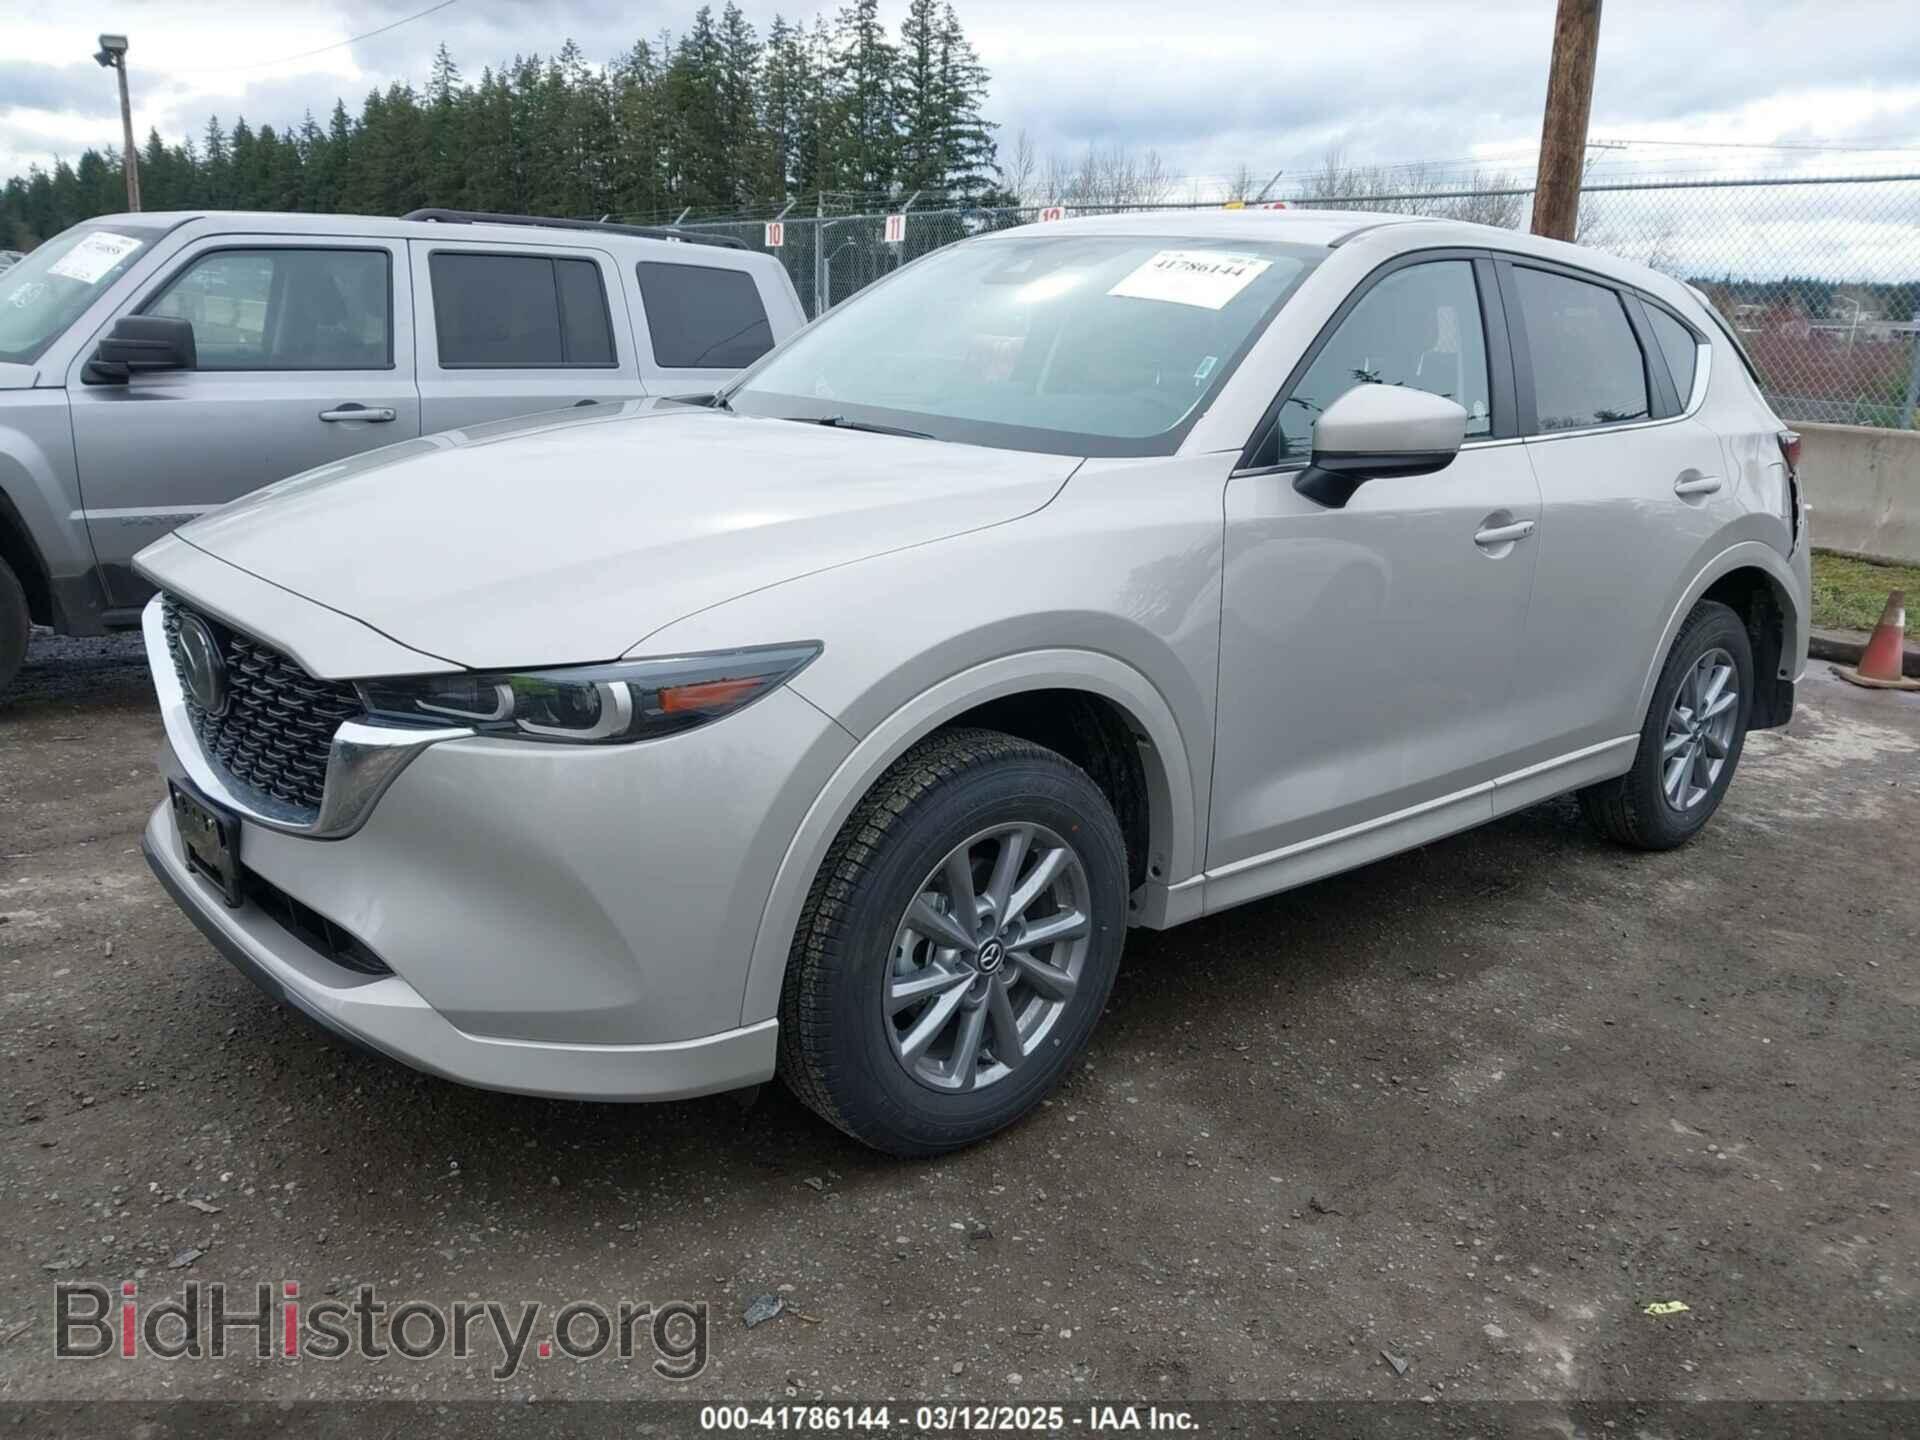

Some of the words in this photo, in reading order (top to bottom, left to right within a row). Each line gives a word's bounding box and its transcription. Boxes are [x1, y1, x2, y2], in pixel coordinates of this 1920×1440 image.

[768, 223, 781, 245] 10
[890, 216, 902, 241] 11
[1155, 260, 1246, 276] 41786144
